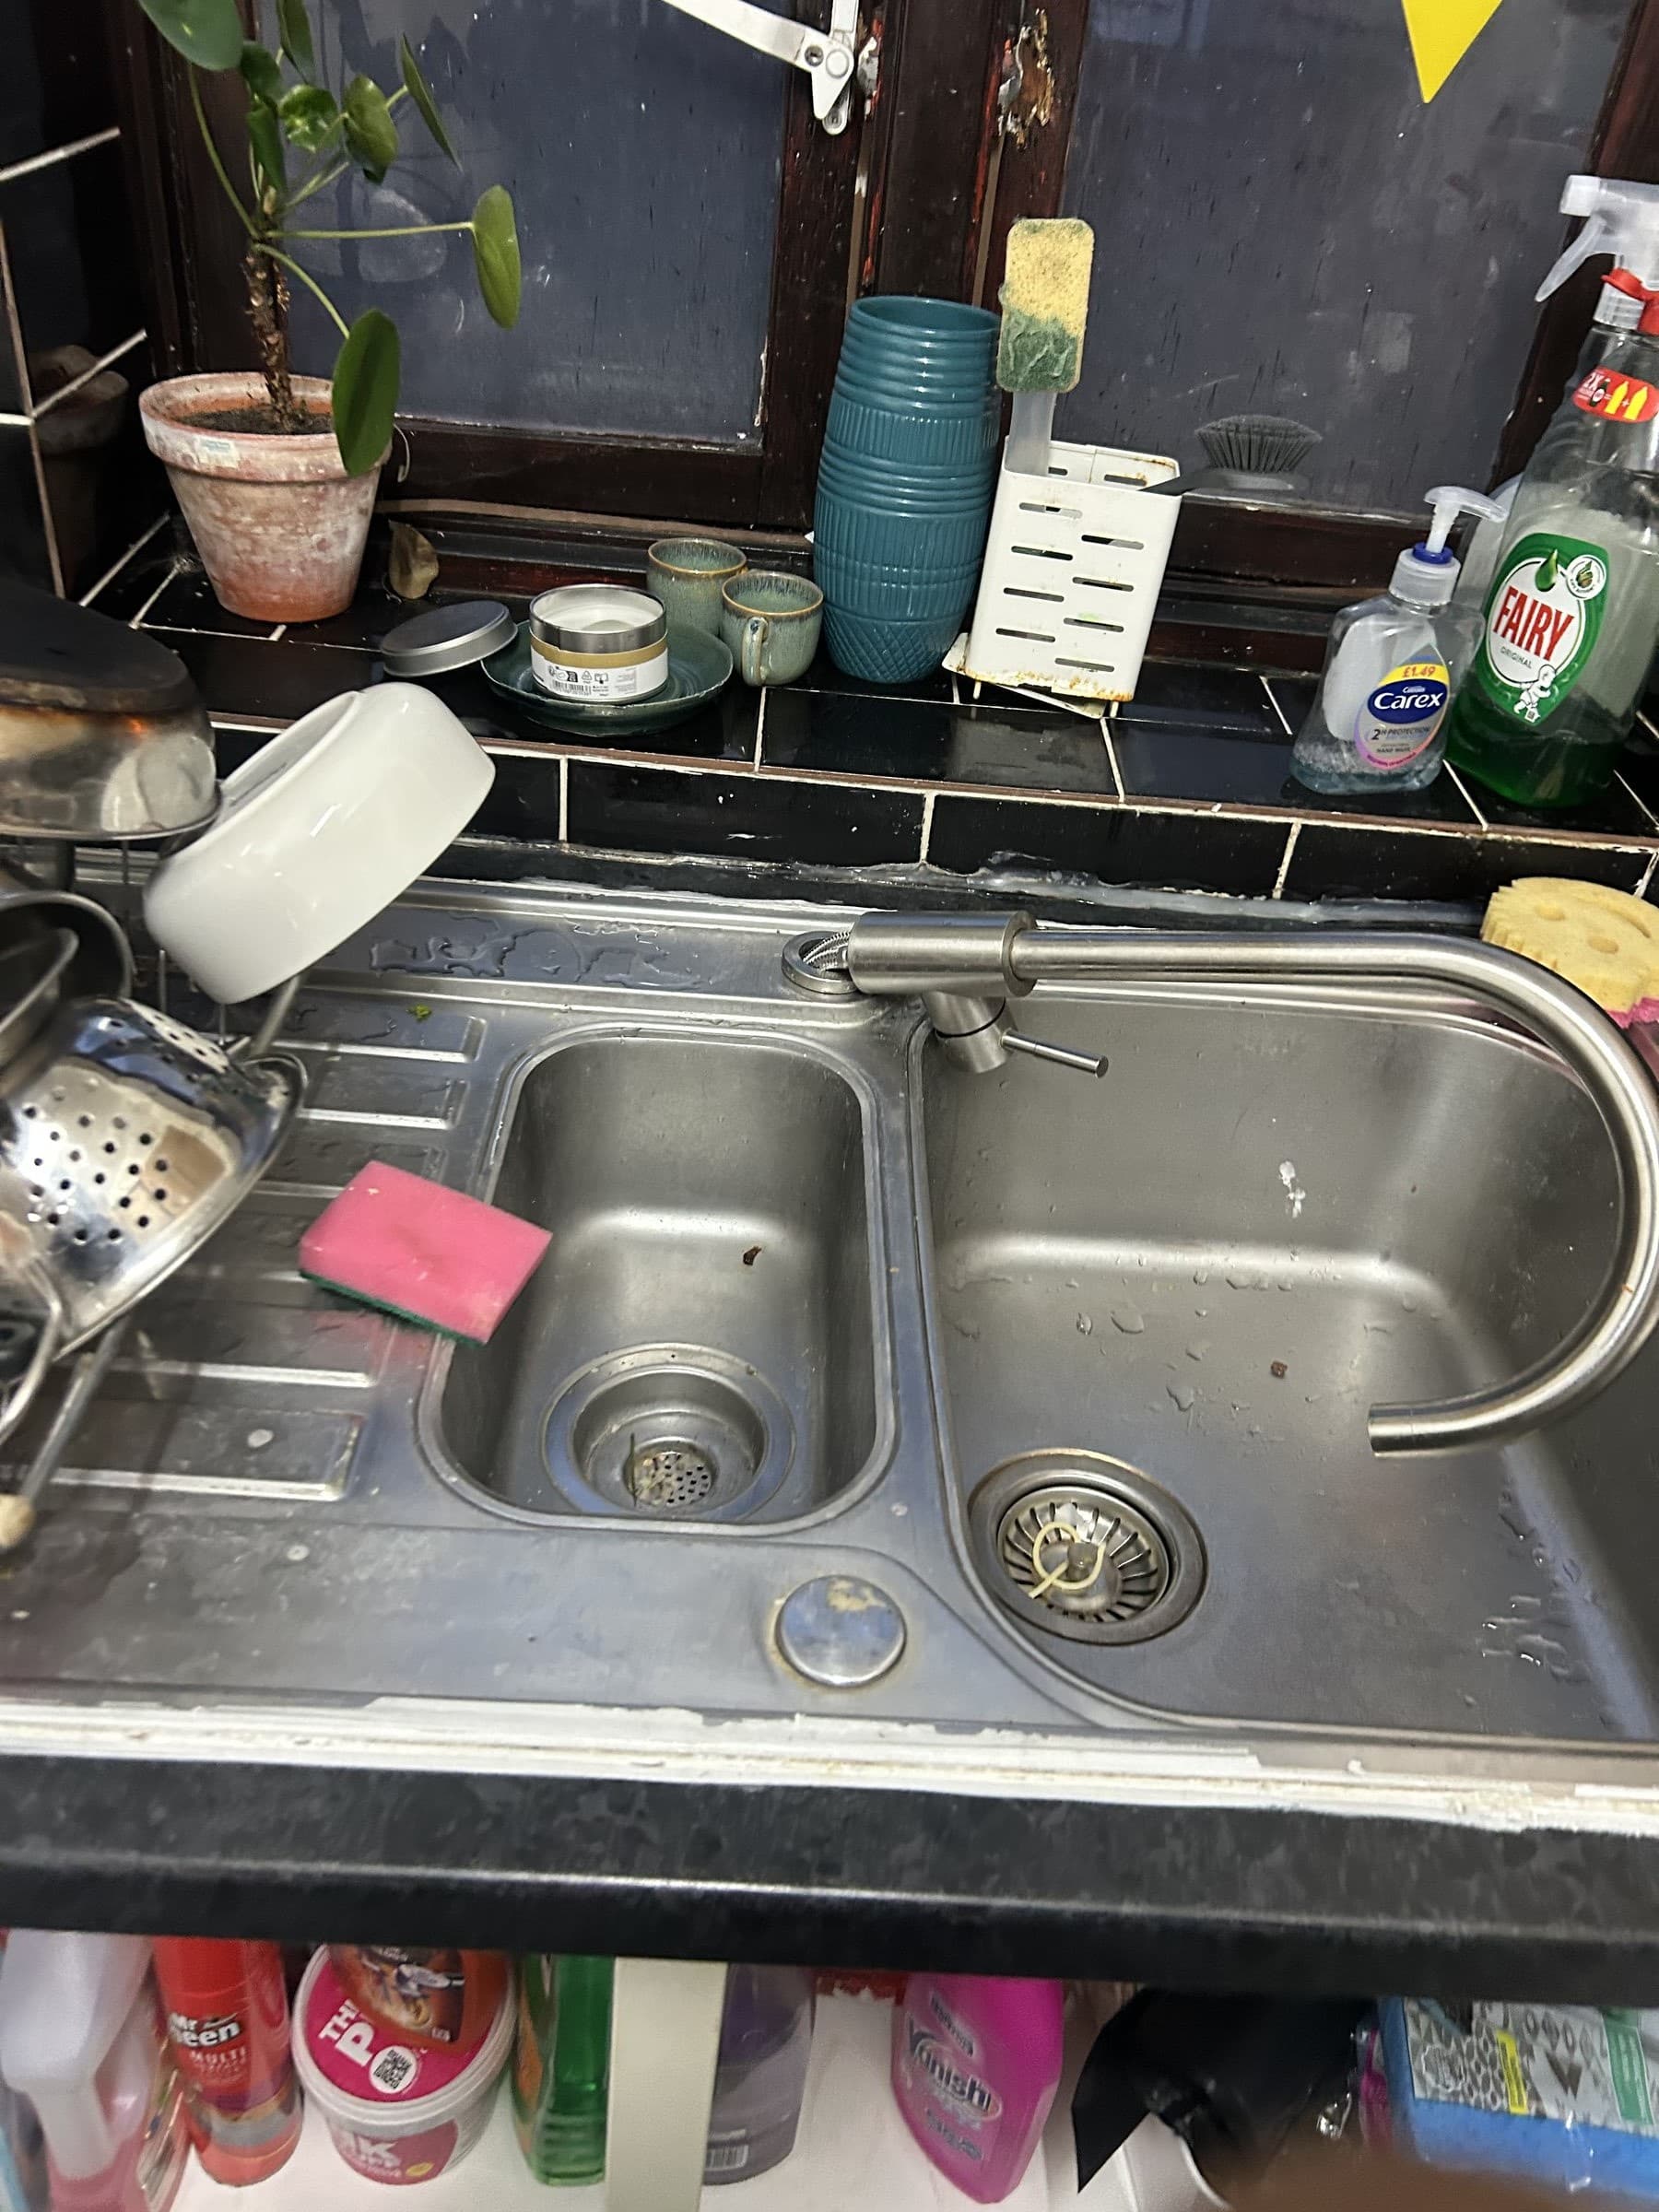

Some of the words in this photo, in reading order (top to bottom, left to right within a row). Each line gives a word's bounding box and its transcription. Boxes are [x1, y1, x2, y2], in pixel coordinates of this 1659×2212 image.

[1493, 585, 1575, 662] FAIRY
[1500, 645, 1533, 670] ORIGINAL
[1402, 665, 1436, 678] £1.49
[1373, 691, 1444, 710] Carex
